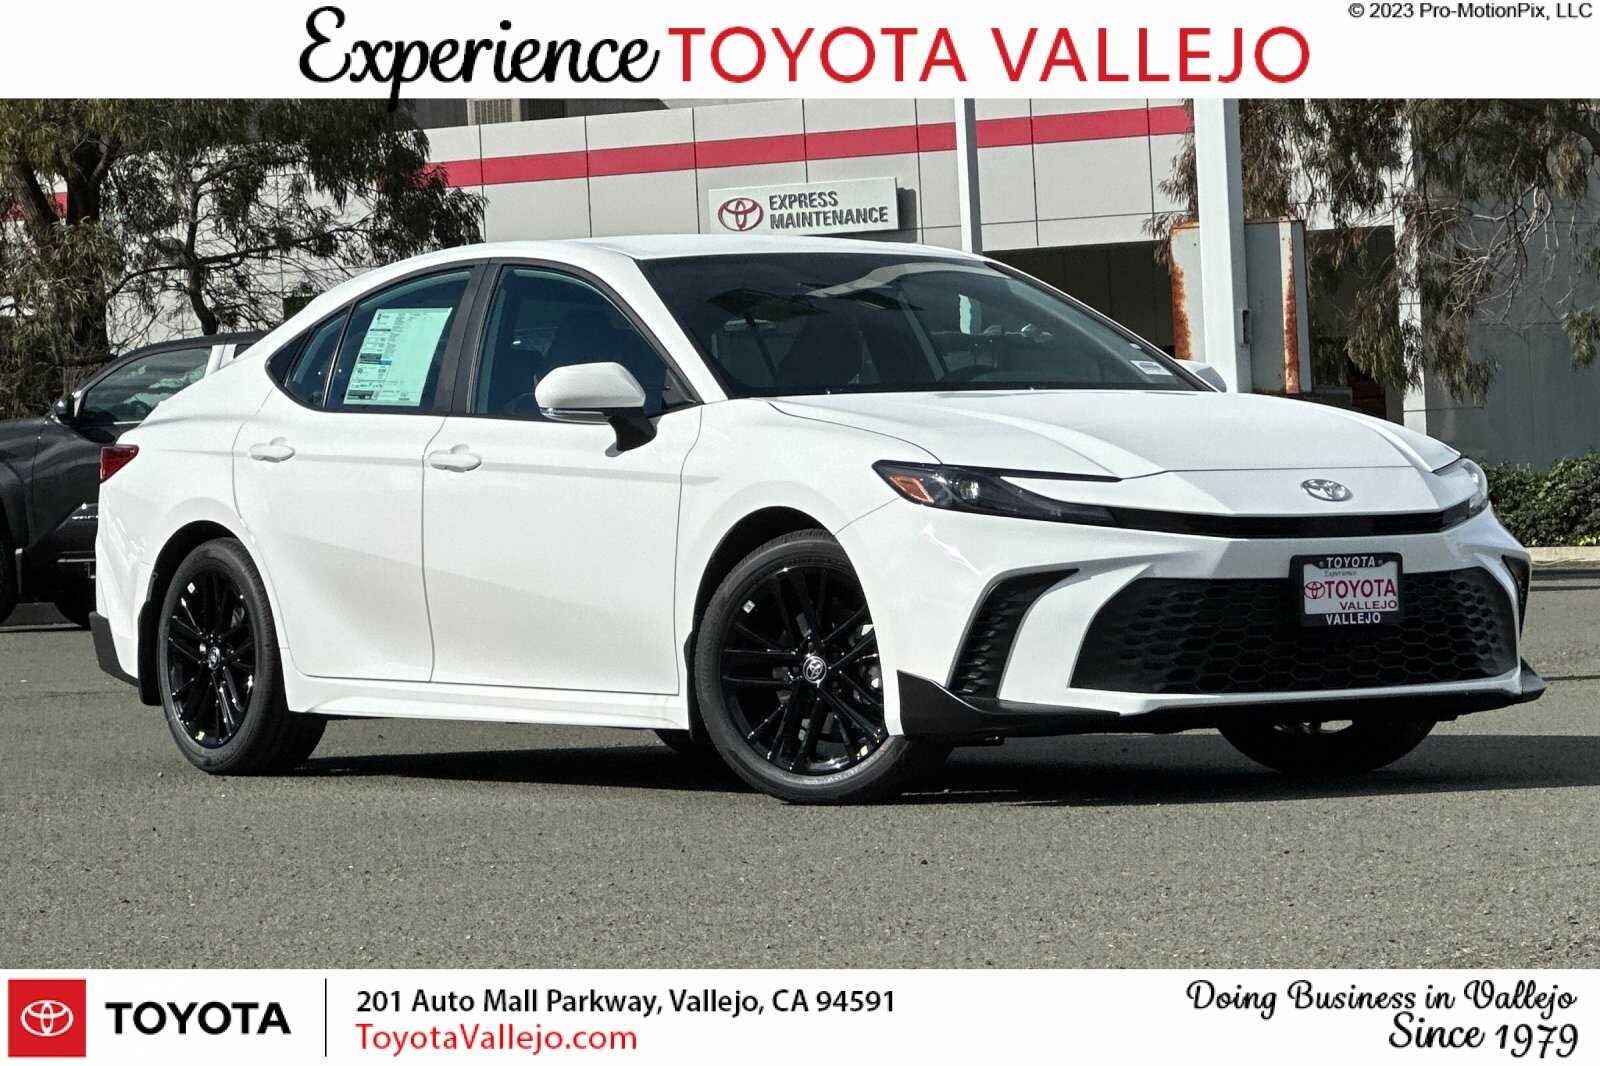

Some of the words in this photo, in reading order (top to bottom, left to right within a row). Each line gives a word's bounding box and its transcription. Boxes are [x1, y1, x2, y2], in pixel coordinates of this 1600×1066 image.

[768, 190, 839, 211] EXPRESS
[769, 206, 889, 230] MAINTENANCE
[1326, 556, 1376, 569] TOYOTA
[1324, 578, 1397, 599] TOYOTA
[1340, 600, 1398, 610] VALLEJO
[1325, 612, 1382, 625] VALLEJO
